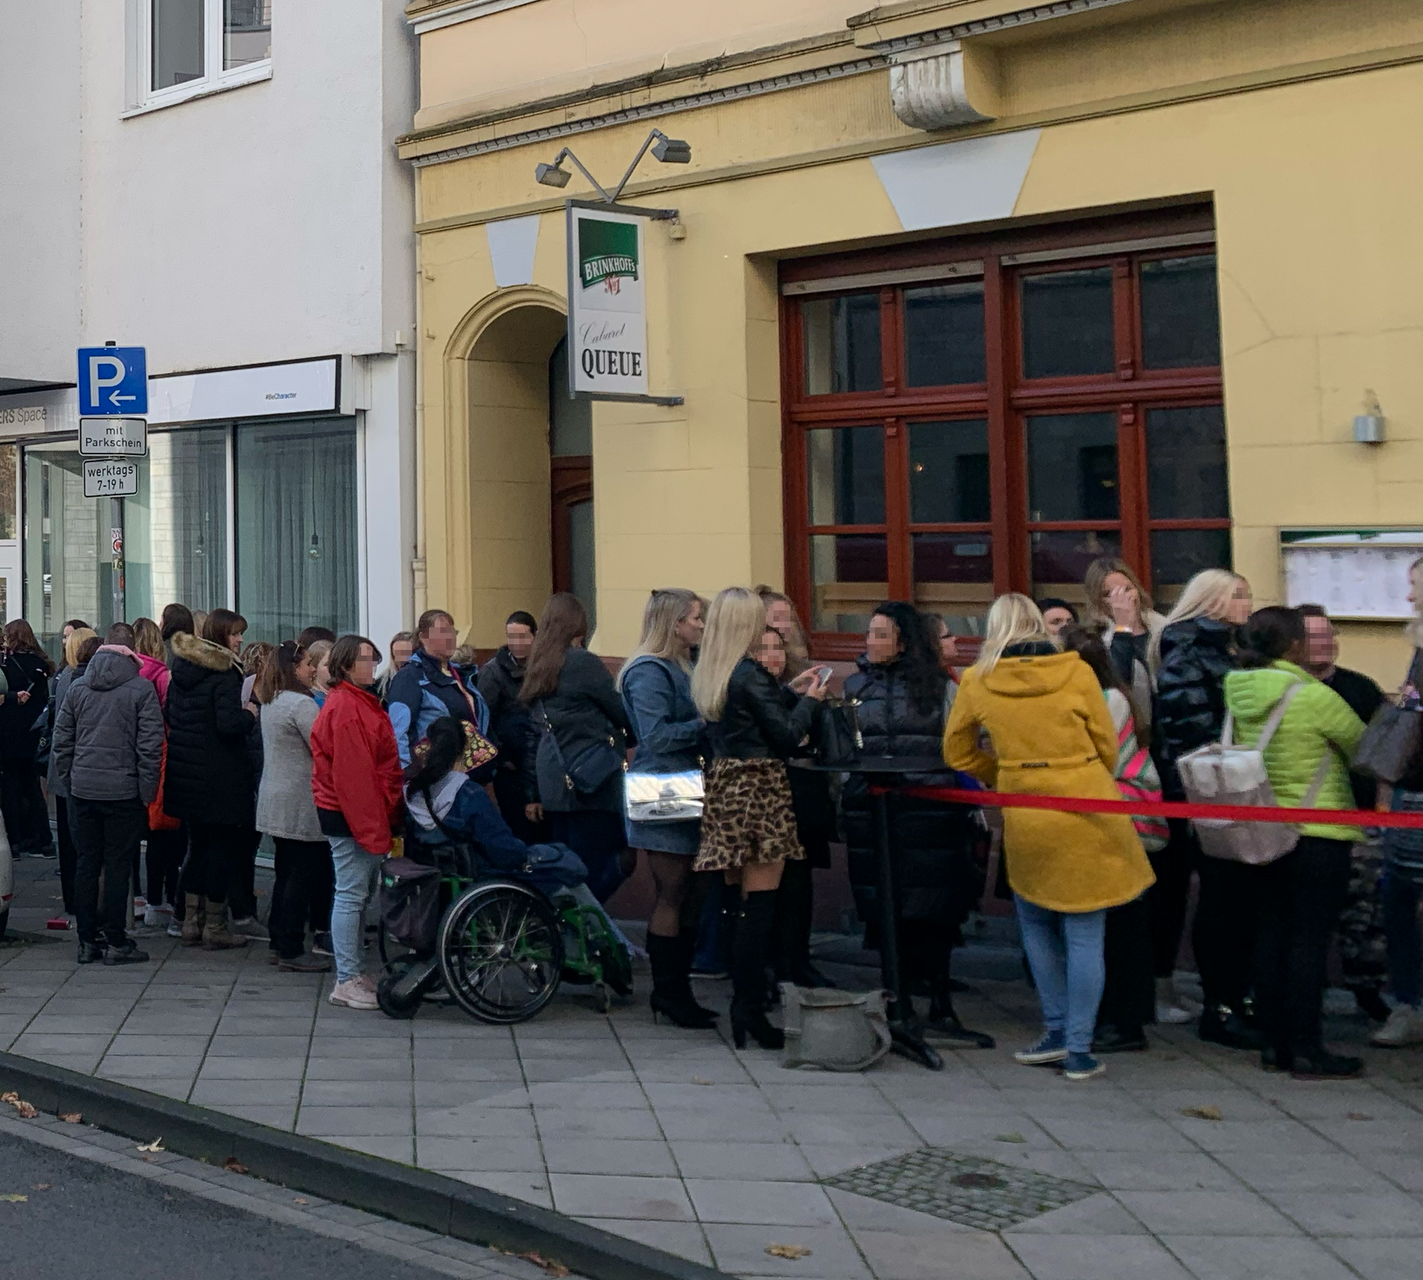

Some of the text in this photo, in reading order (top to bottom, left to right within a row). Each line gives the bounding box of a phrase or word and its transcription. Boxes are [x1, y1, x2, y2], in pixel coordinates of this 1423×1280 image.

[579, 321, 626, 346] Cabaret
[581, 348, 642, 379] QUEUE
[89, 356, 126, 407] P
[17, 407, 47, 425] Space
[106, 426, 123, 435] mit
[85, 437, 142, 448] Parkschein
[87, 465, 134, 478] werktags
[97, 478, 124, 491] 7-19 h
